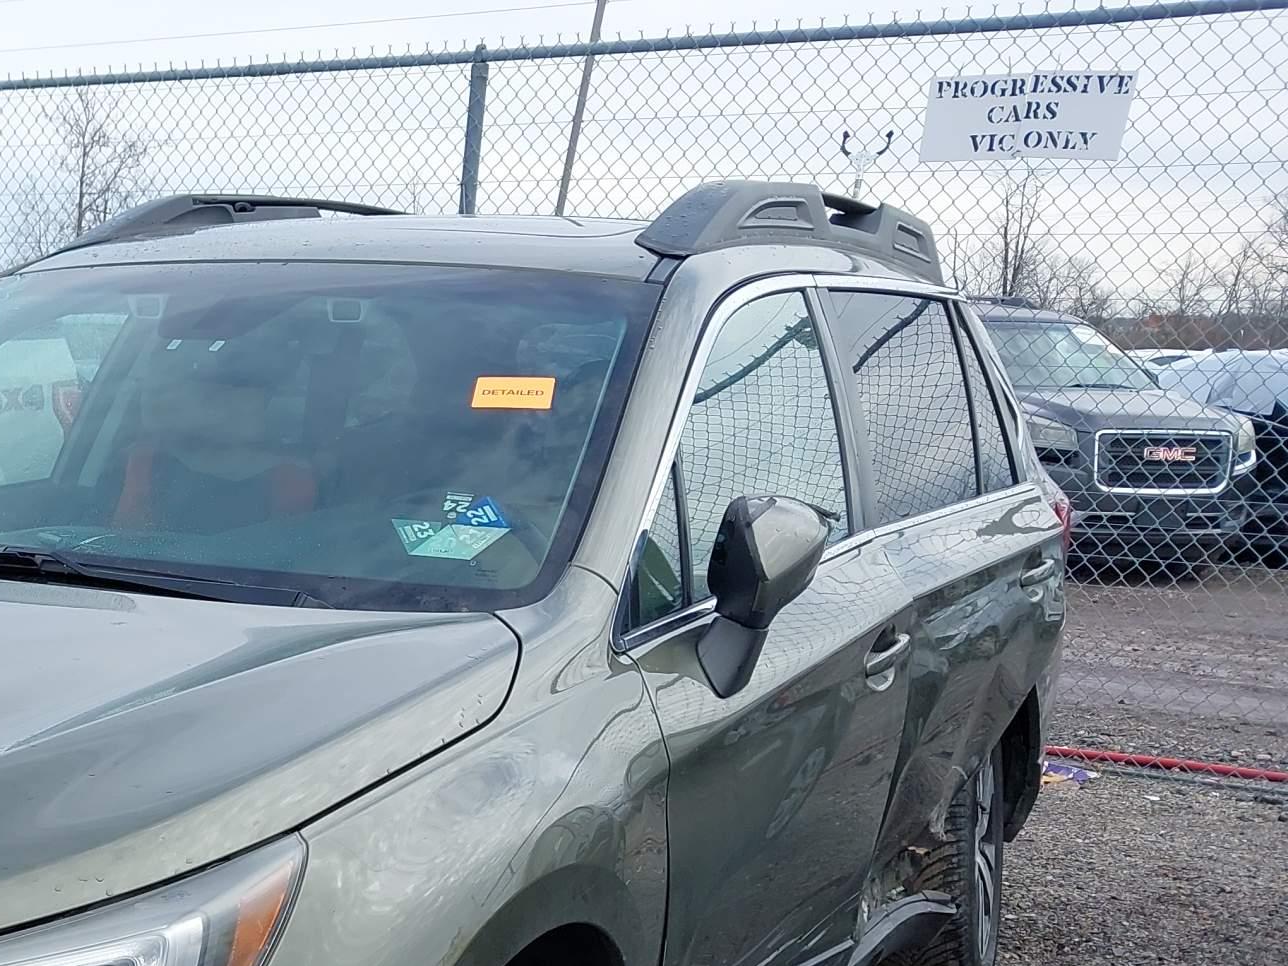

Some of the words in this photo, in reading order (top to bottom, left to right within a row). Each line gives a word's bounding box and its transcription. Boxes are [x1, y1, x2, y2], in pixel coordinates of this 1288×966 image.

[935, 73, 1134, 99] PROGRESSIVE
[986, 100, 1060, 124] CARS
[968, 133, 1016, 153] VIC
[1022, 130, 1099, 151] ONLY
[481, 388, 545, 397] DETAILED
[1143, 446, 1198, 461] GMC
